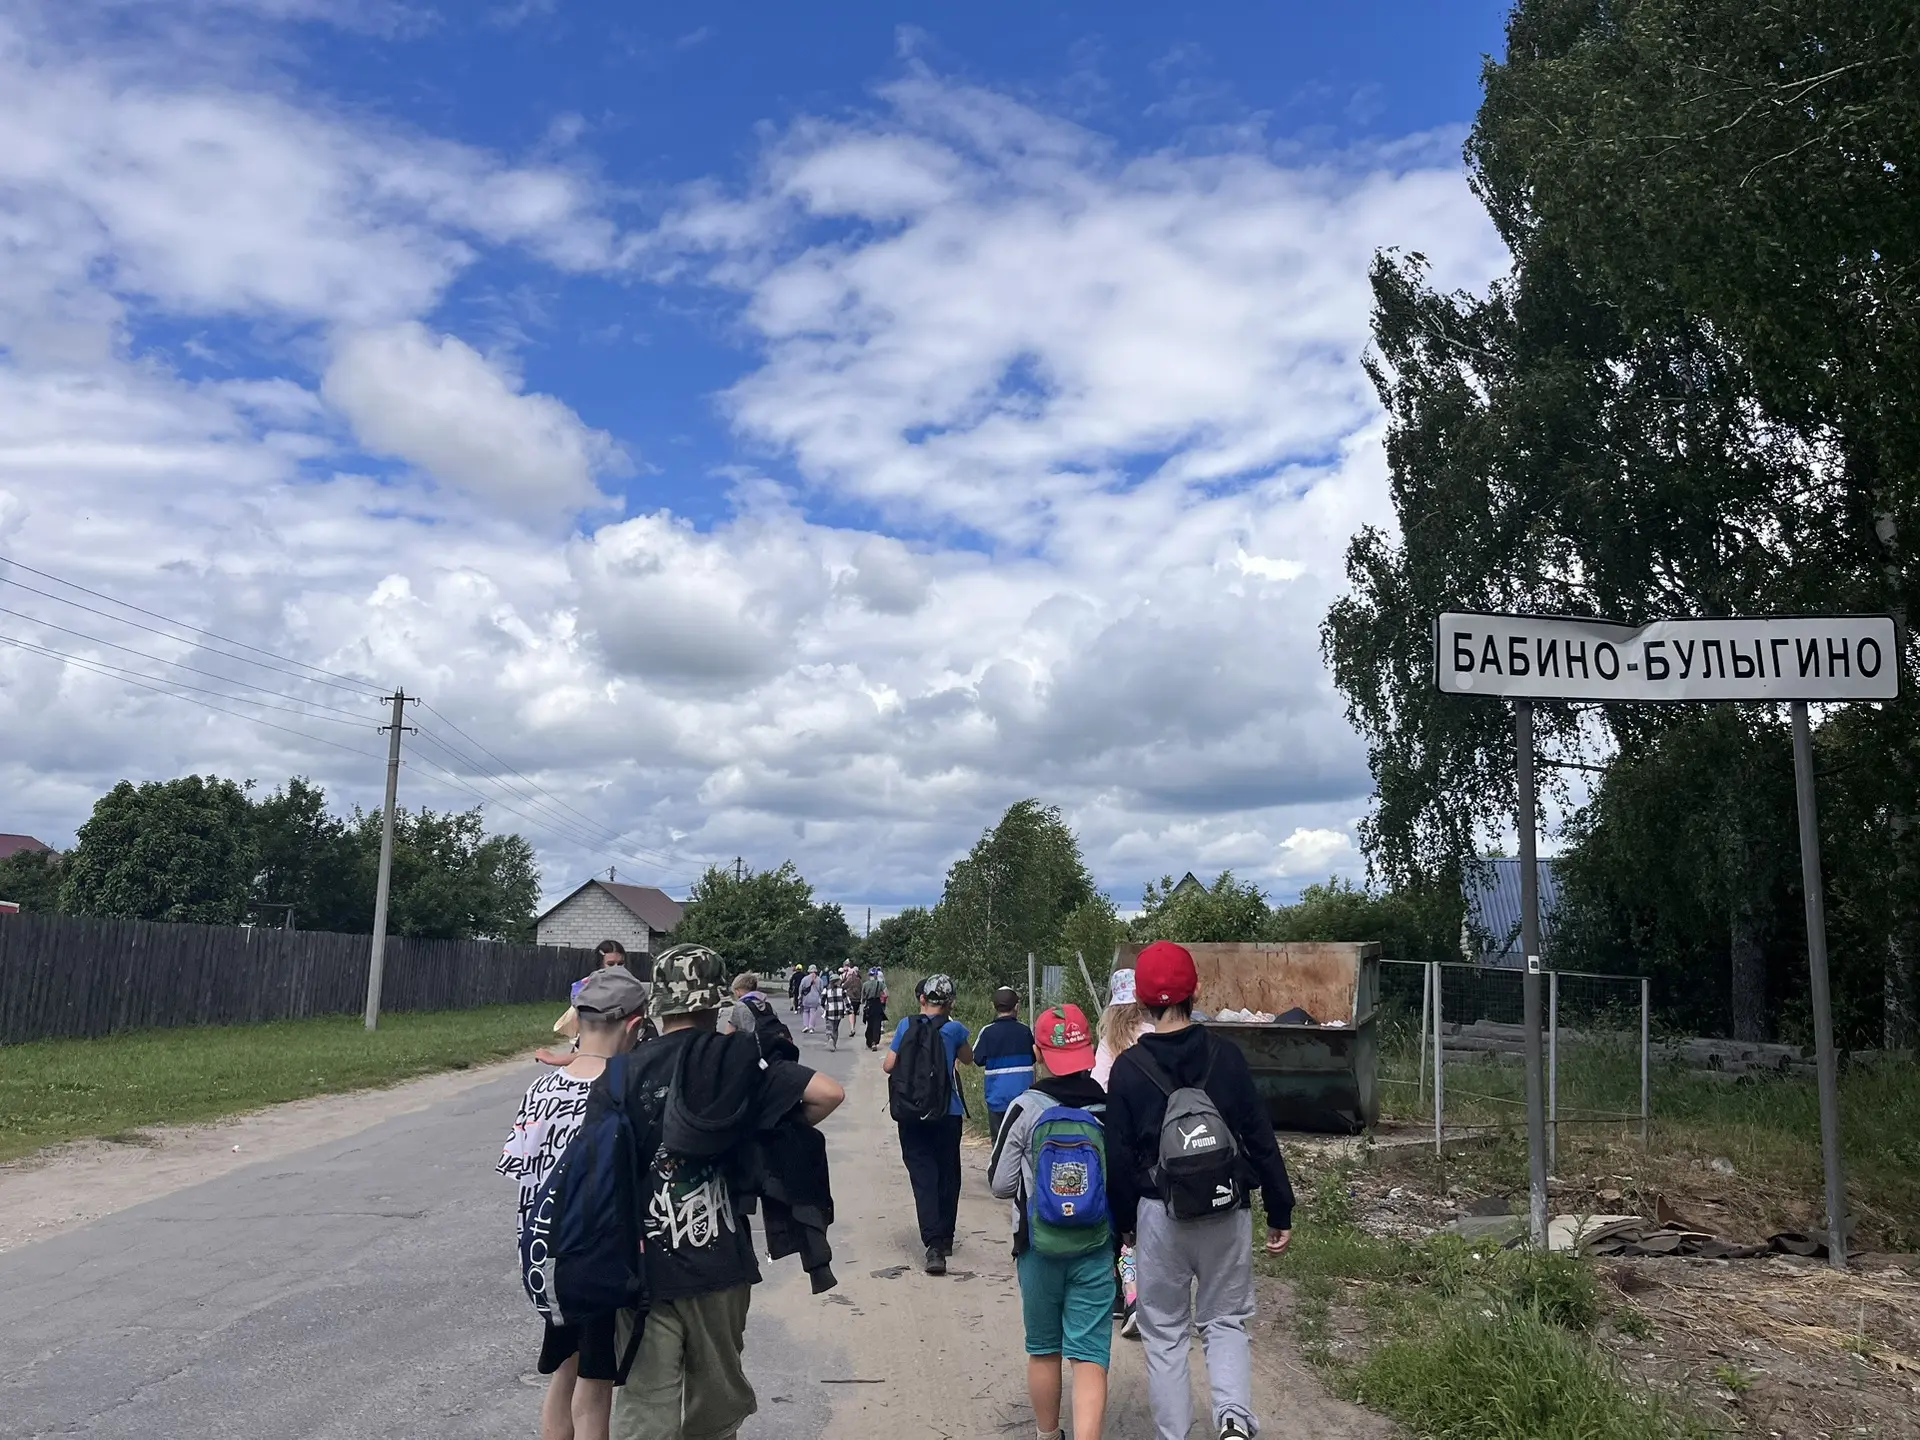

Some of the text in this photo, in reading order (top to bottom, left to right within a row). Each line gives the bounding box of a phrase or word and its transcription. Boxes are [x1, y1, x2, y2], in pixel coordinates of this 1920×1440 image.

[1453, 631, 1883, 681] БАБИНО-БУЛЫГИНО
[1191, 1135, 1217, 1149] PUMA
[1211, 1194, 1232, 1207] PUMA
